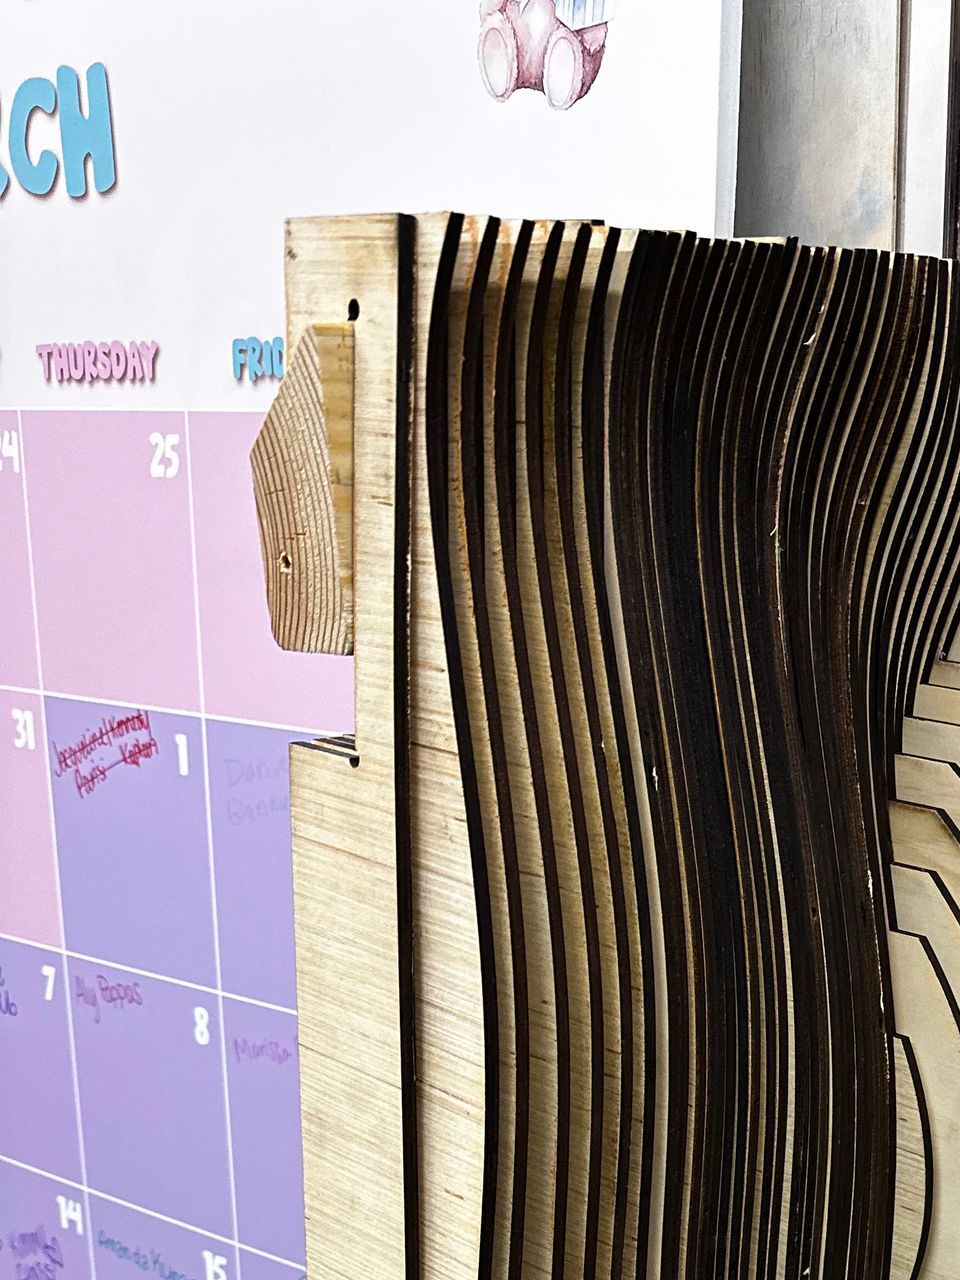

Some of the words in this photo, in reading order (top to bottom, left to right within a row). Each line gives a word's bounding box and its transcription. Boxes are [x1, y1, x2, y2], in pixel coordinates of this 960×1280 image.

[0, 62, 117, 199] CH
[36, 340, 160, 382] THURSDAY
[232, 336, 285, 382] FRID
[0, 430, 20, 474] 4
[149, 432, 180, 479] 25
[11, 708, 36, 751] 31
[175, 733, 189, 777] 1
[41, 965, 56, 1001] 7
[194, 1006, 210, 1045] 8
[56, 1195, 84, 1235] 14
